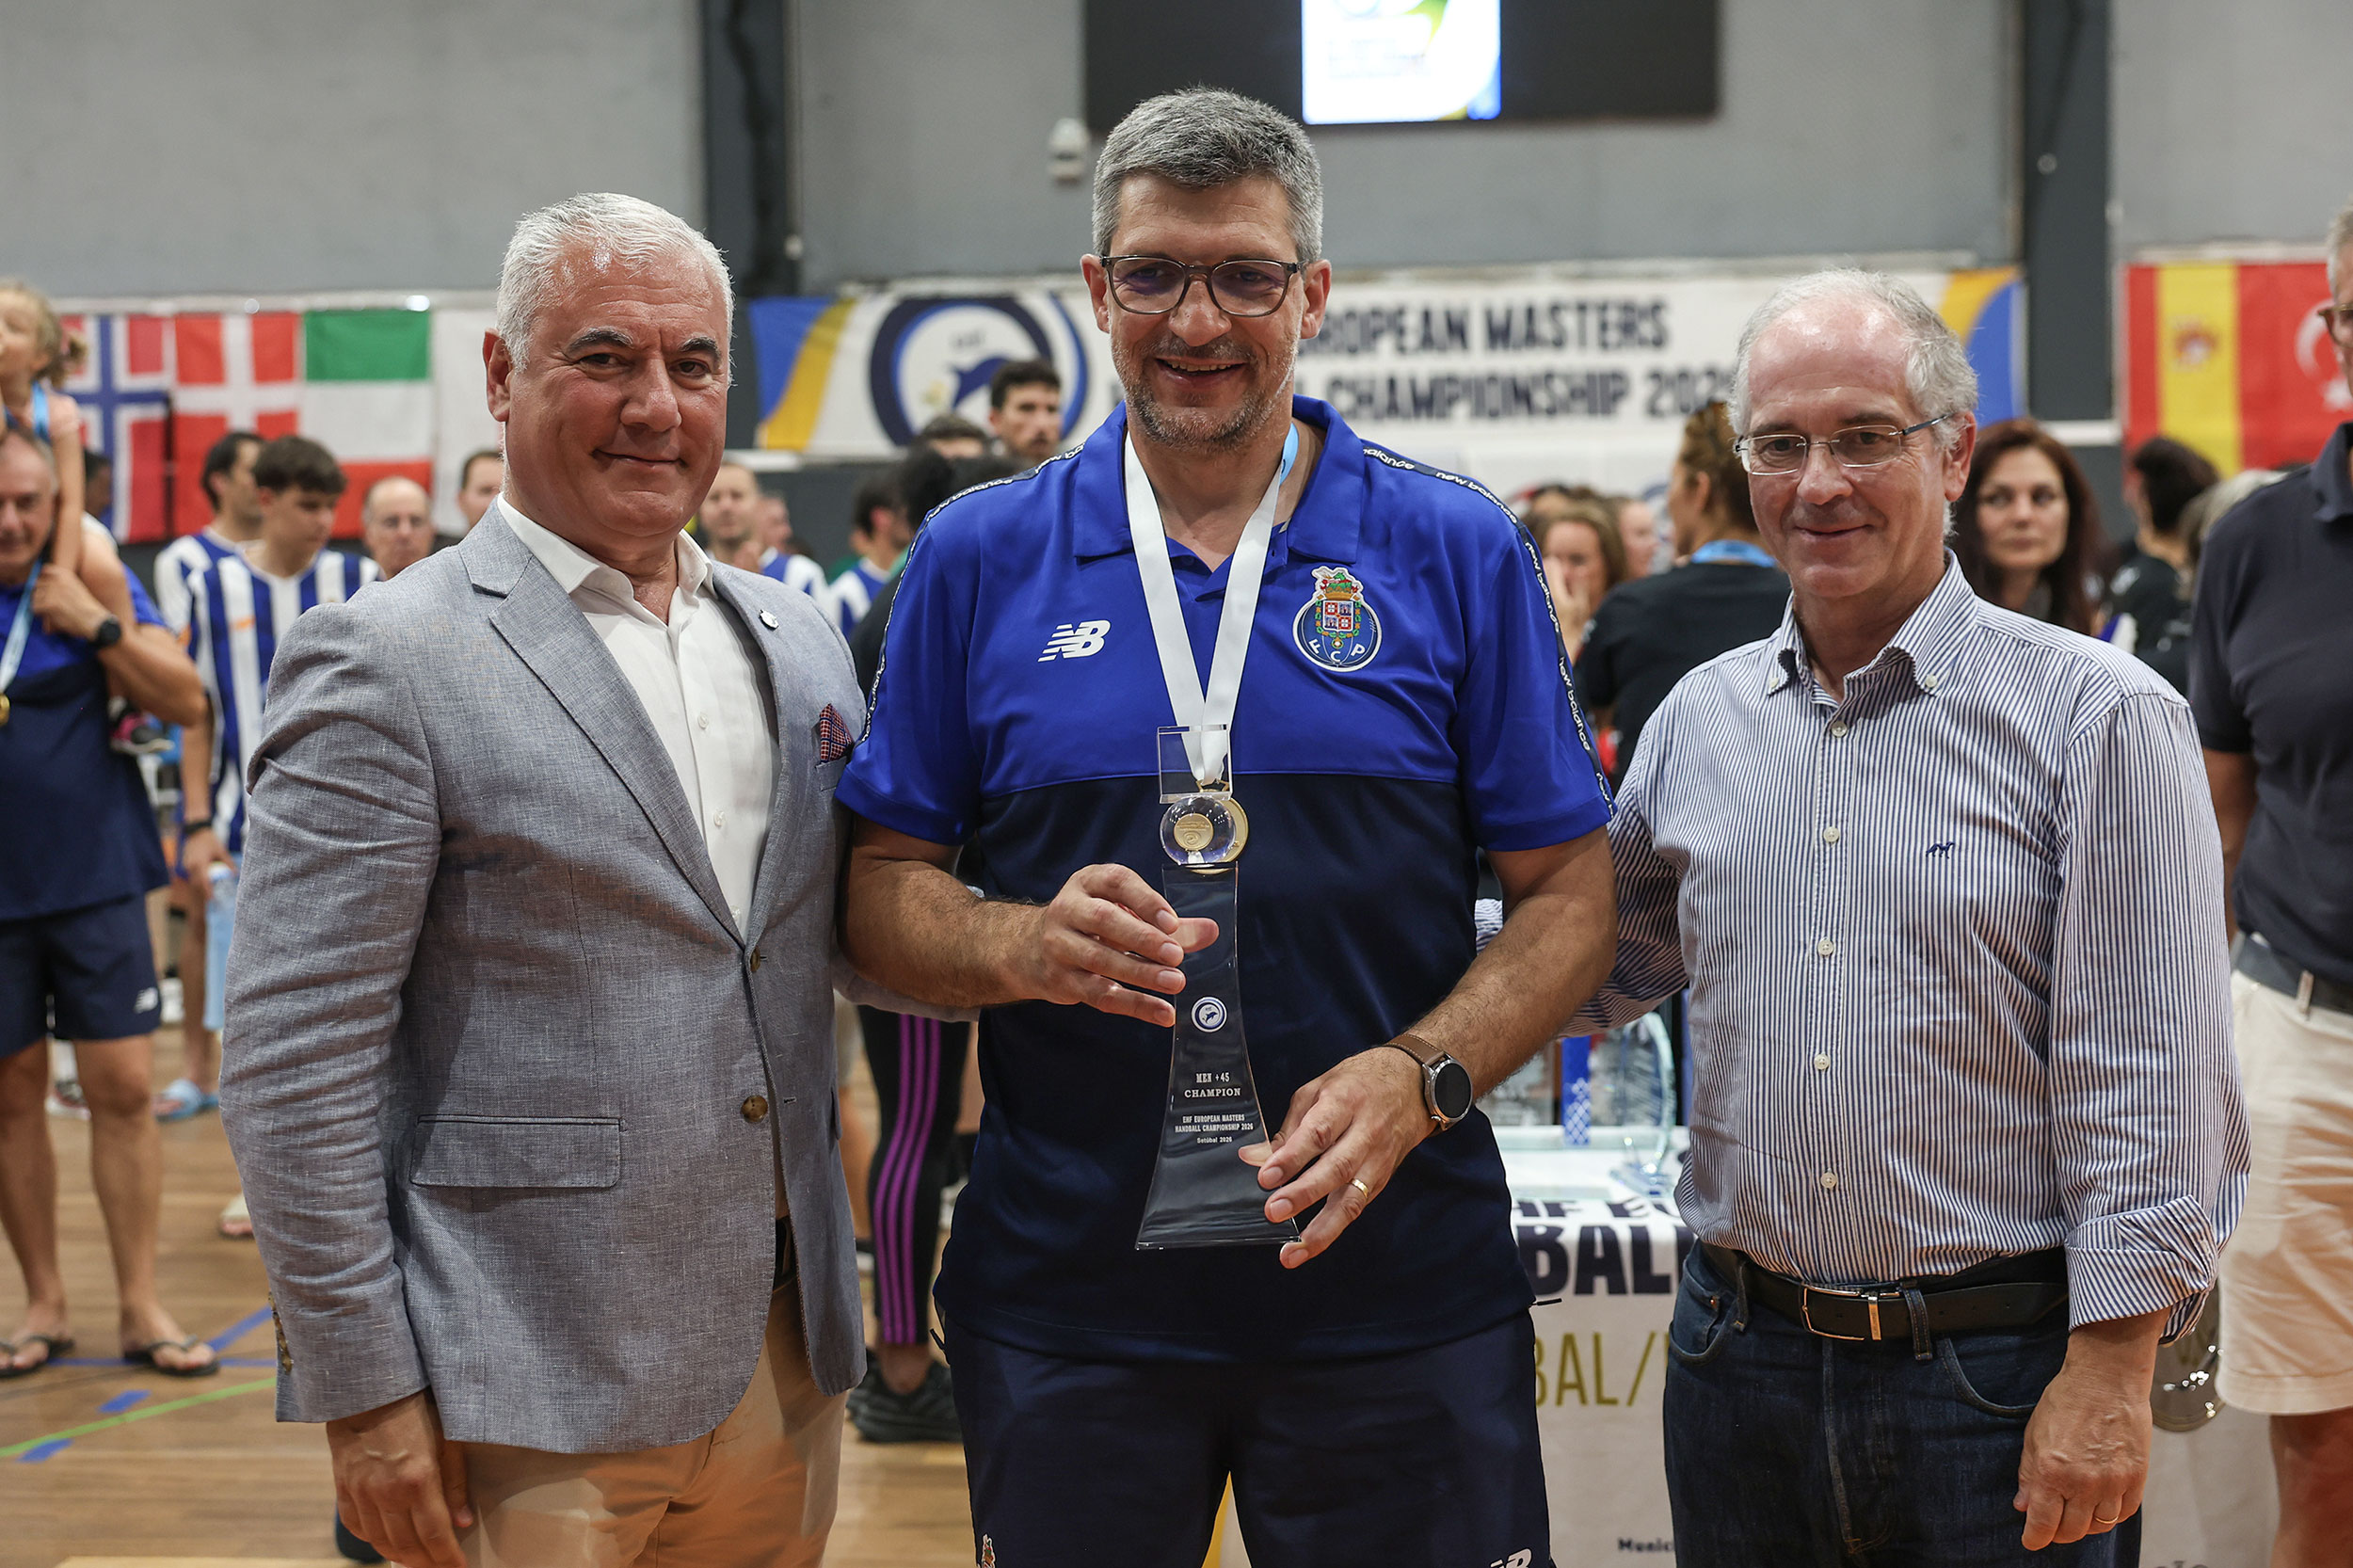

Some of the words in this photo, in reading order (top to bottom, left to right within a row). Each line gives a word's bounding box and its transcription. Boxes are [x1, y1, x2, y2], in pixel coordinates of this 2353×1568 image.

[1485, 297, 1671, 348] MASTERS
[1435, 471, 1467, 486] new
[1467, 481, 1518, 524] balance
[1558, 656, 1573, 687] new
[1567, 689, 1591, 751] balance
[1195, 1073, 1212, 1083] MEN
[1215, 1072, 1230, 1082] +45
[1184, 1087, 1241, 1098] CHAMPION
[1193, 1114, 1221, 1123] EUROPEAN
[1222, 1113, 1245, 1122] MASTERS
[1175, 1125, 1201, 1133] HANDBALL
[1202, 1123, 1240, 1132] CHAMPIONSHIP
